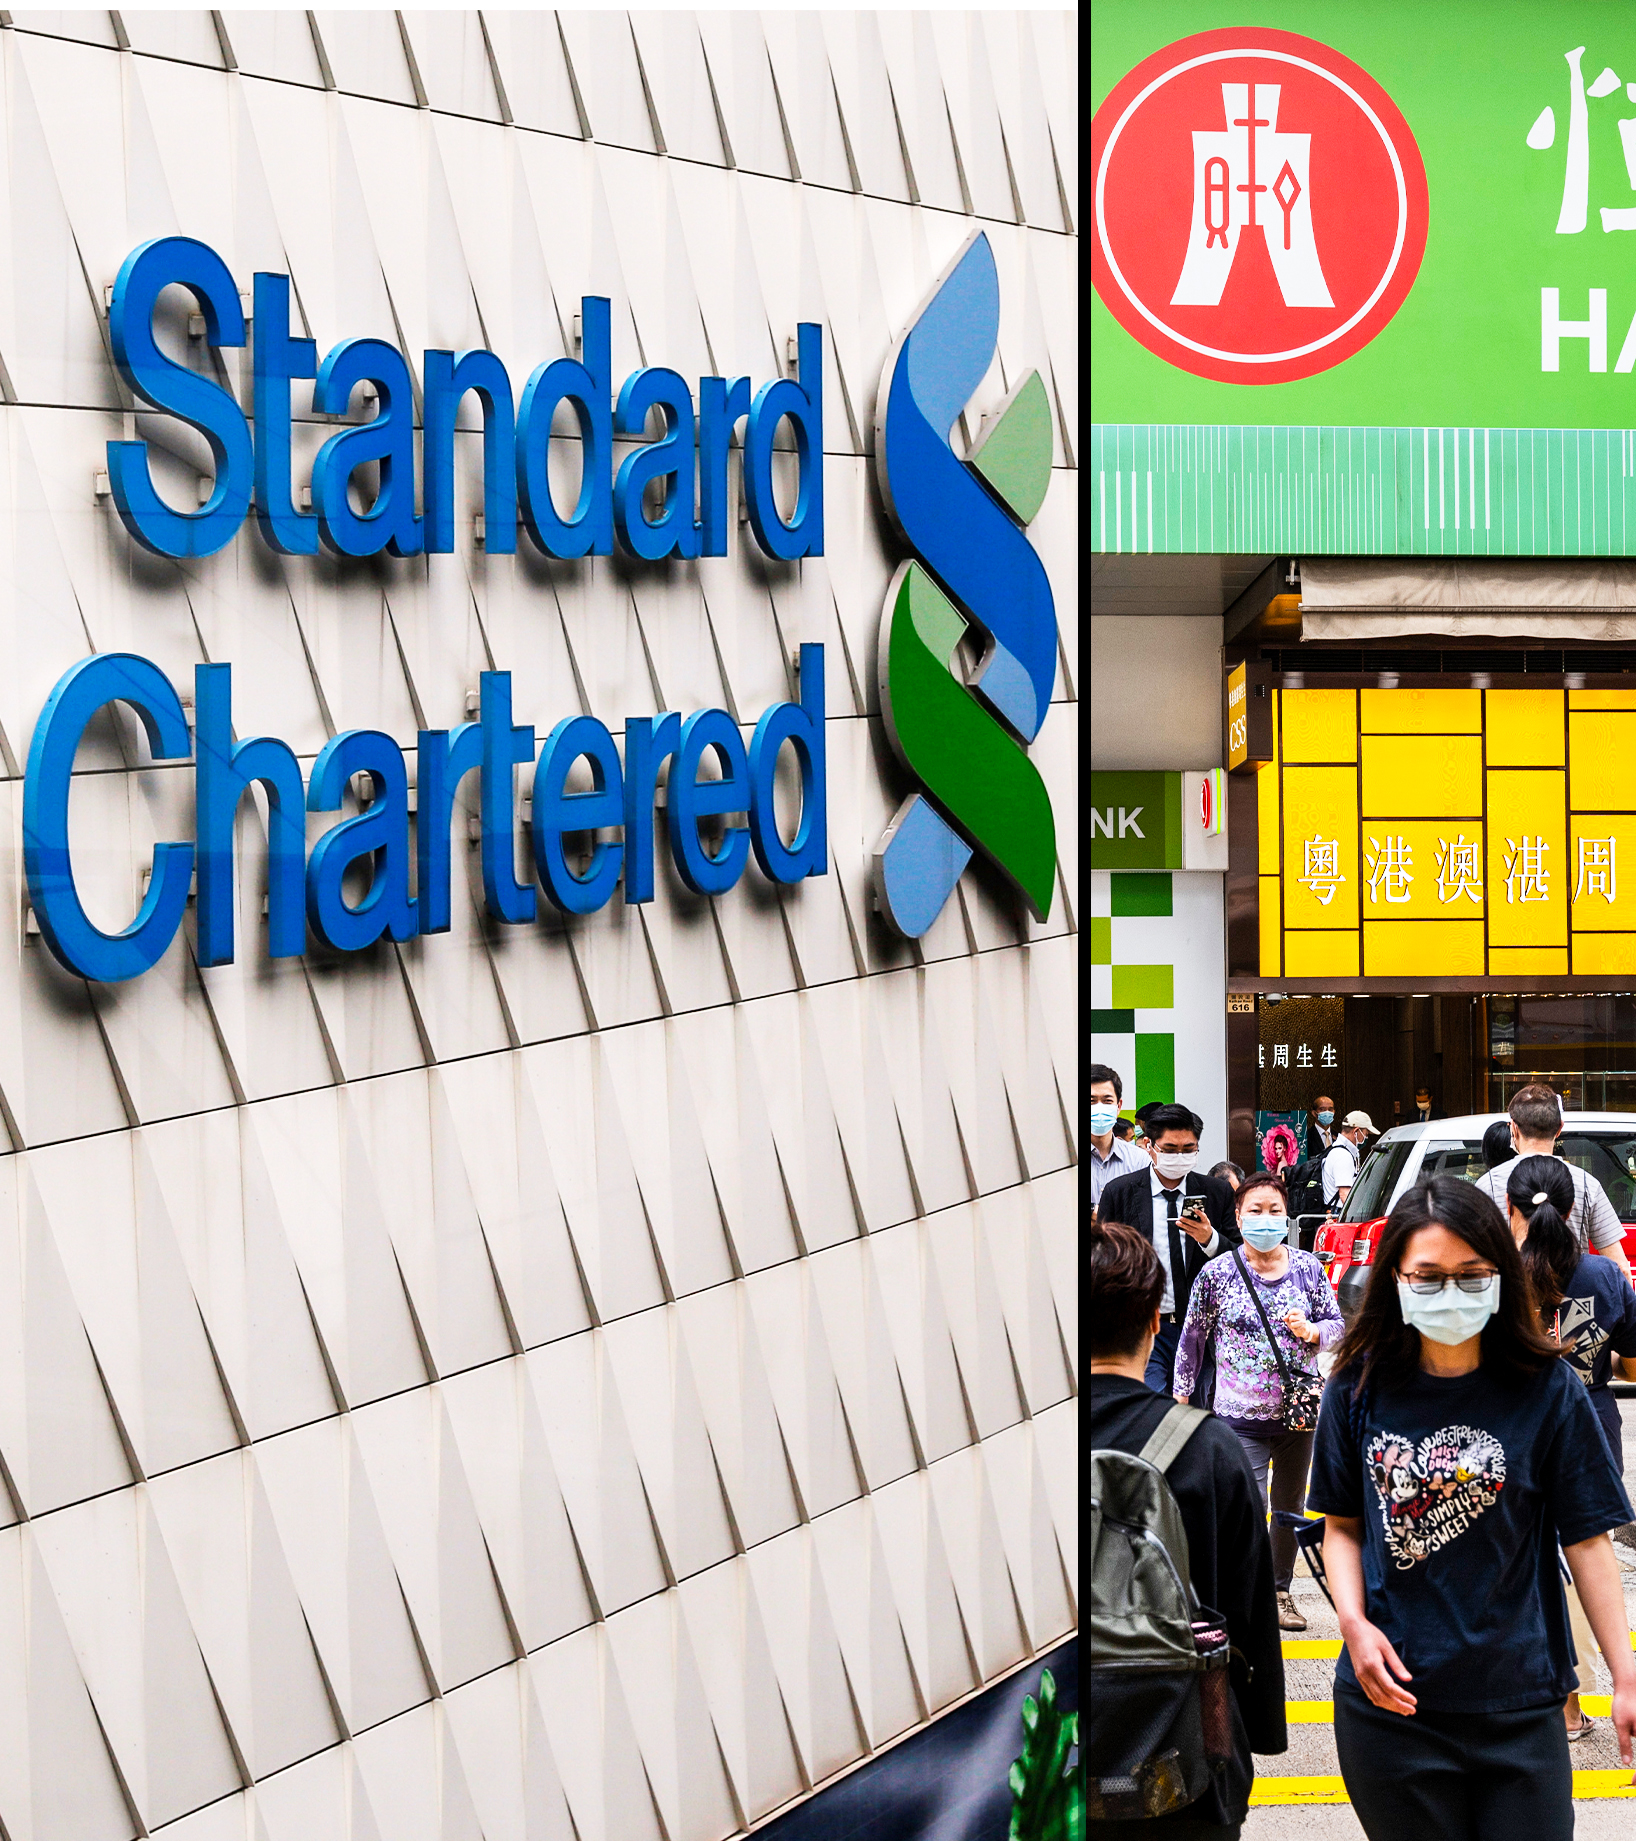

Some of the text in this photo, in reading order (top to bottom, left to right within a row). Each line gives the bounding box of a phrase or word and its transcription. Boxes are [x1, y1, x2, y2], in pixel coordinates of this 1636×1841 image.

[106, 235, 824, 561] Standard
[1229, 714, 1246, 752] CSS
[23, 642, 828, 982] Chartered
[1232, 1003, 1250, 1012] 616
[1427, 1492, 1472, 1527] SIMPLY
[1430, 1512, 1470, 1552] SWEET
